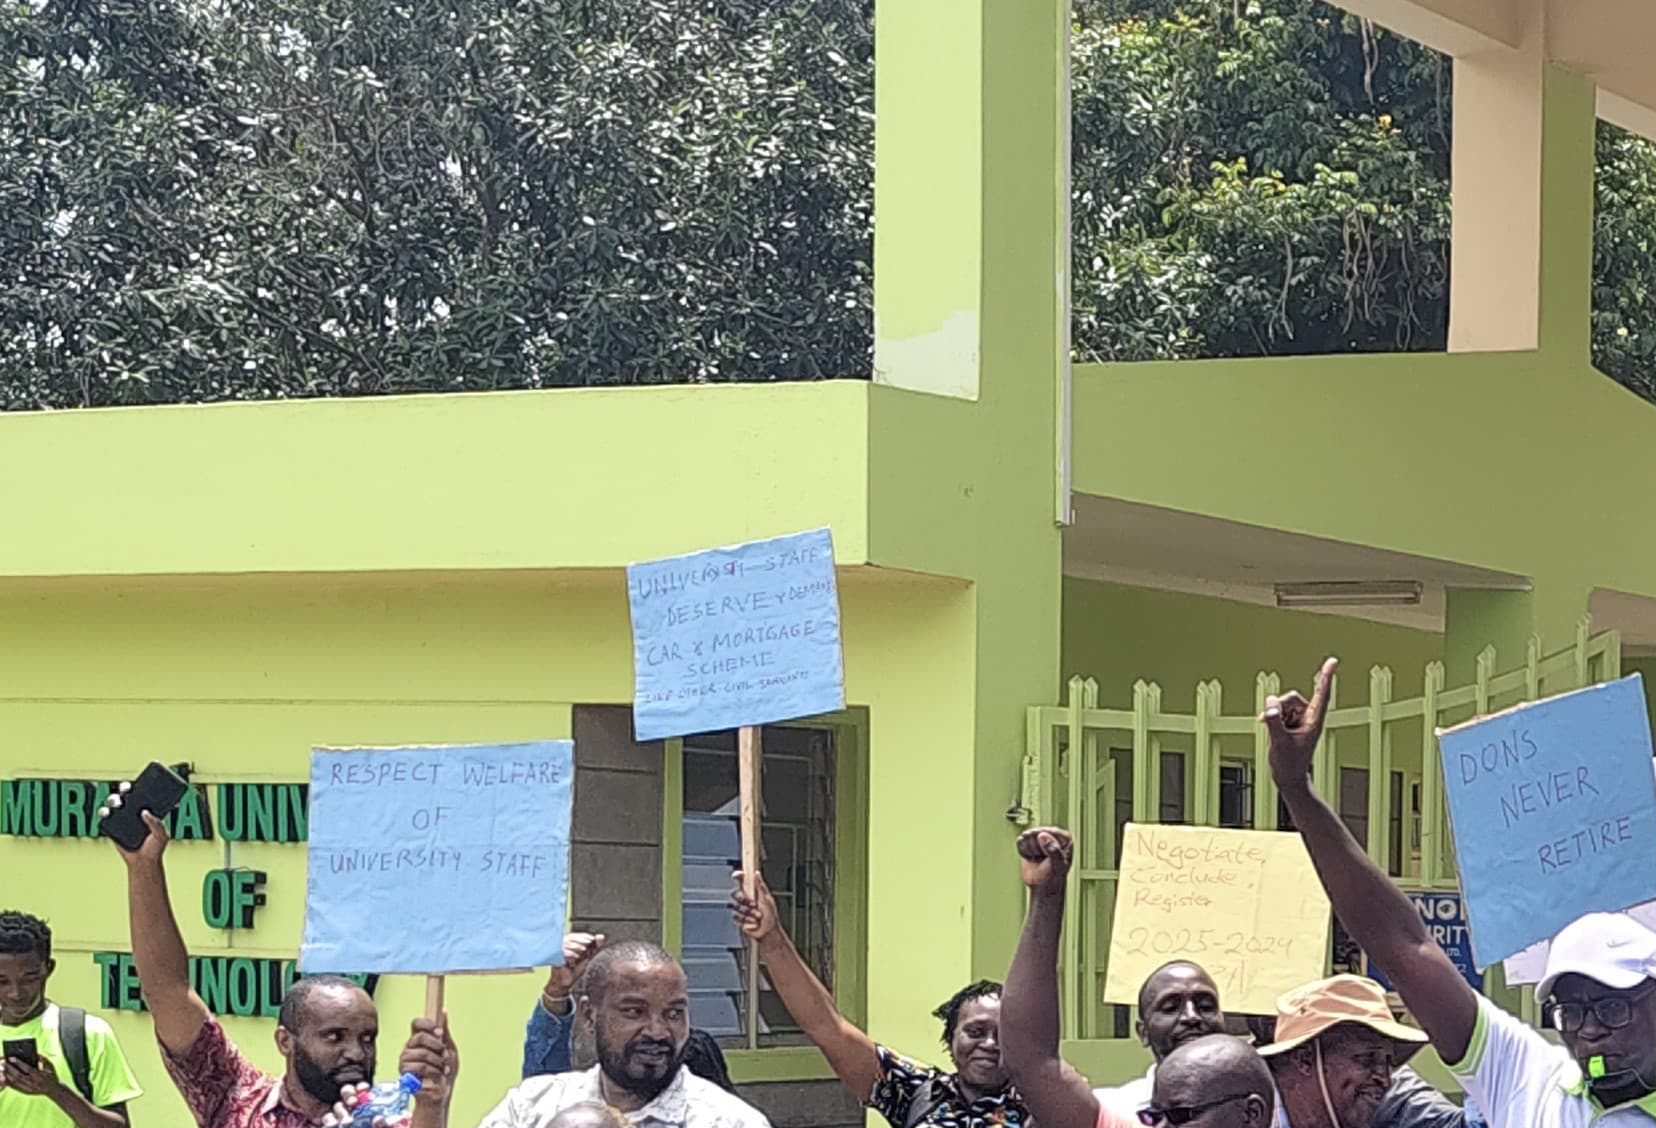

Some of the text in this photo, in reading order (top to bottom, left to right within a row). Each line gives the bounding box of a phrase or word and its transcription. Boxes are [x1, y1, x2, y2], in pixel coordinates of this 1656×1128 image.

[765, 547, 819, 571] STAFF
[667, 592, 769, 627] DESERVE
[647, 642, 683, 666] CAR
[713, 620, 816, 653] MORTGAGE
[684, 651, 776, 677] SCHEME
[330, 761, 562, 786] RESPECT WELFARE
[1460, 729, 1537, 786] DONS
[1501, 766, 1599, 829] NEVER
[412, 806, 450, 830] OF
[1538, 816, 1632, 875] RETIRE
[330, 848, 546, 879] UNIVERSITY STAFF
[203, 869, 260, 929] OF
